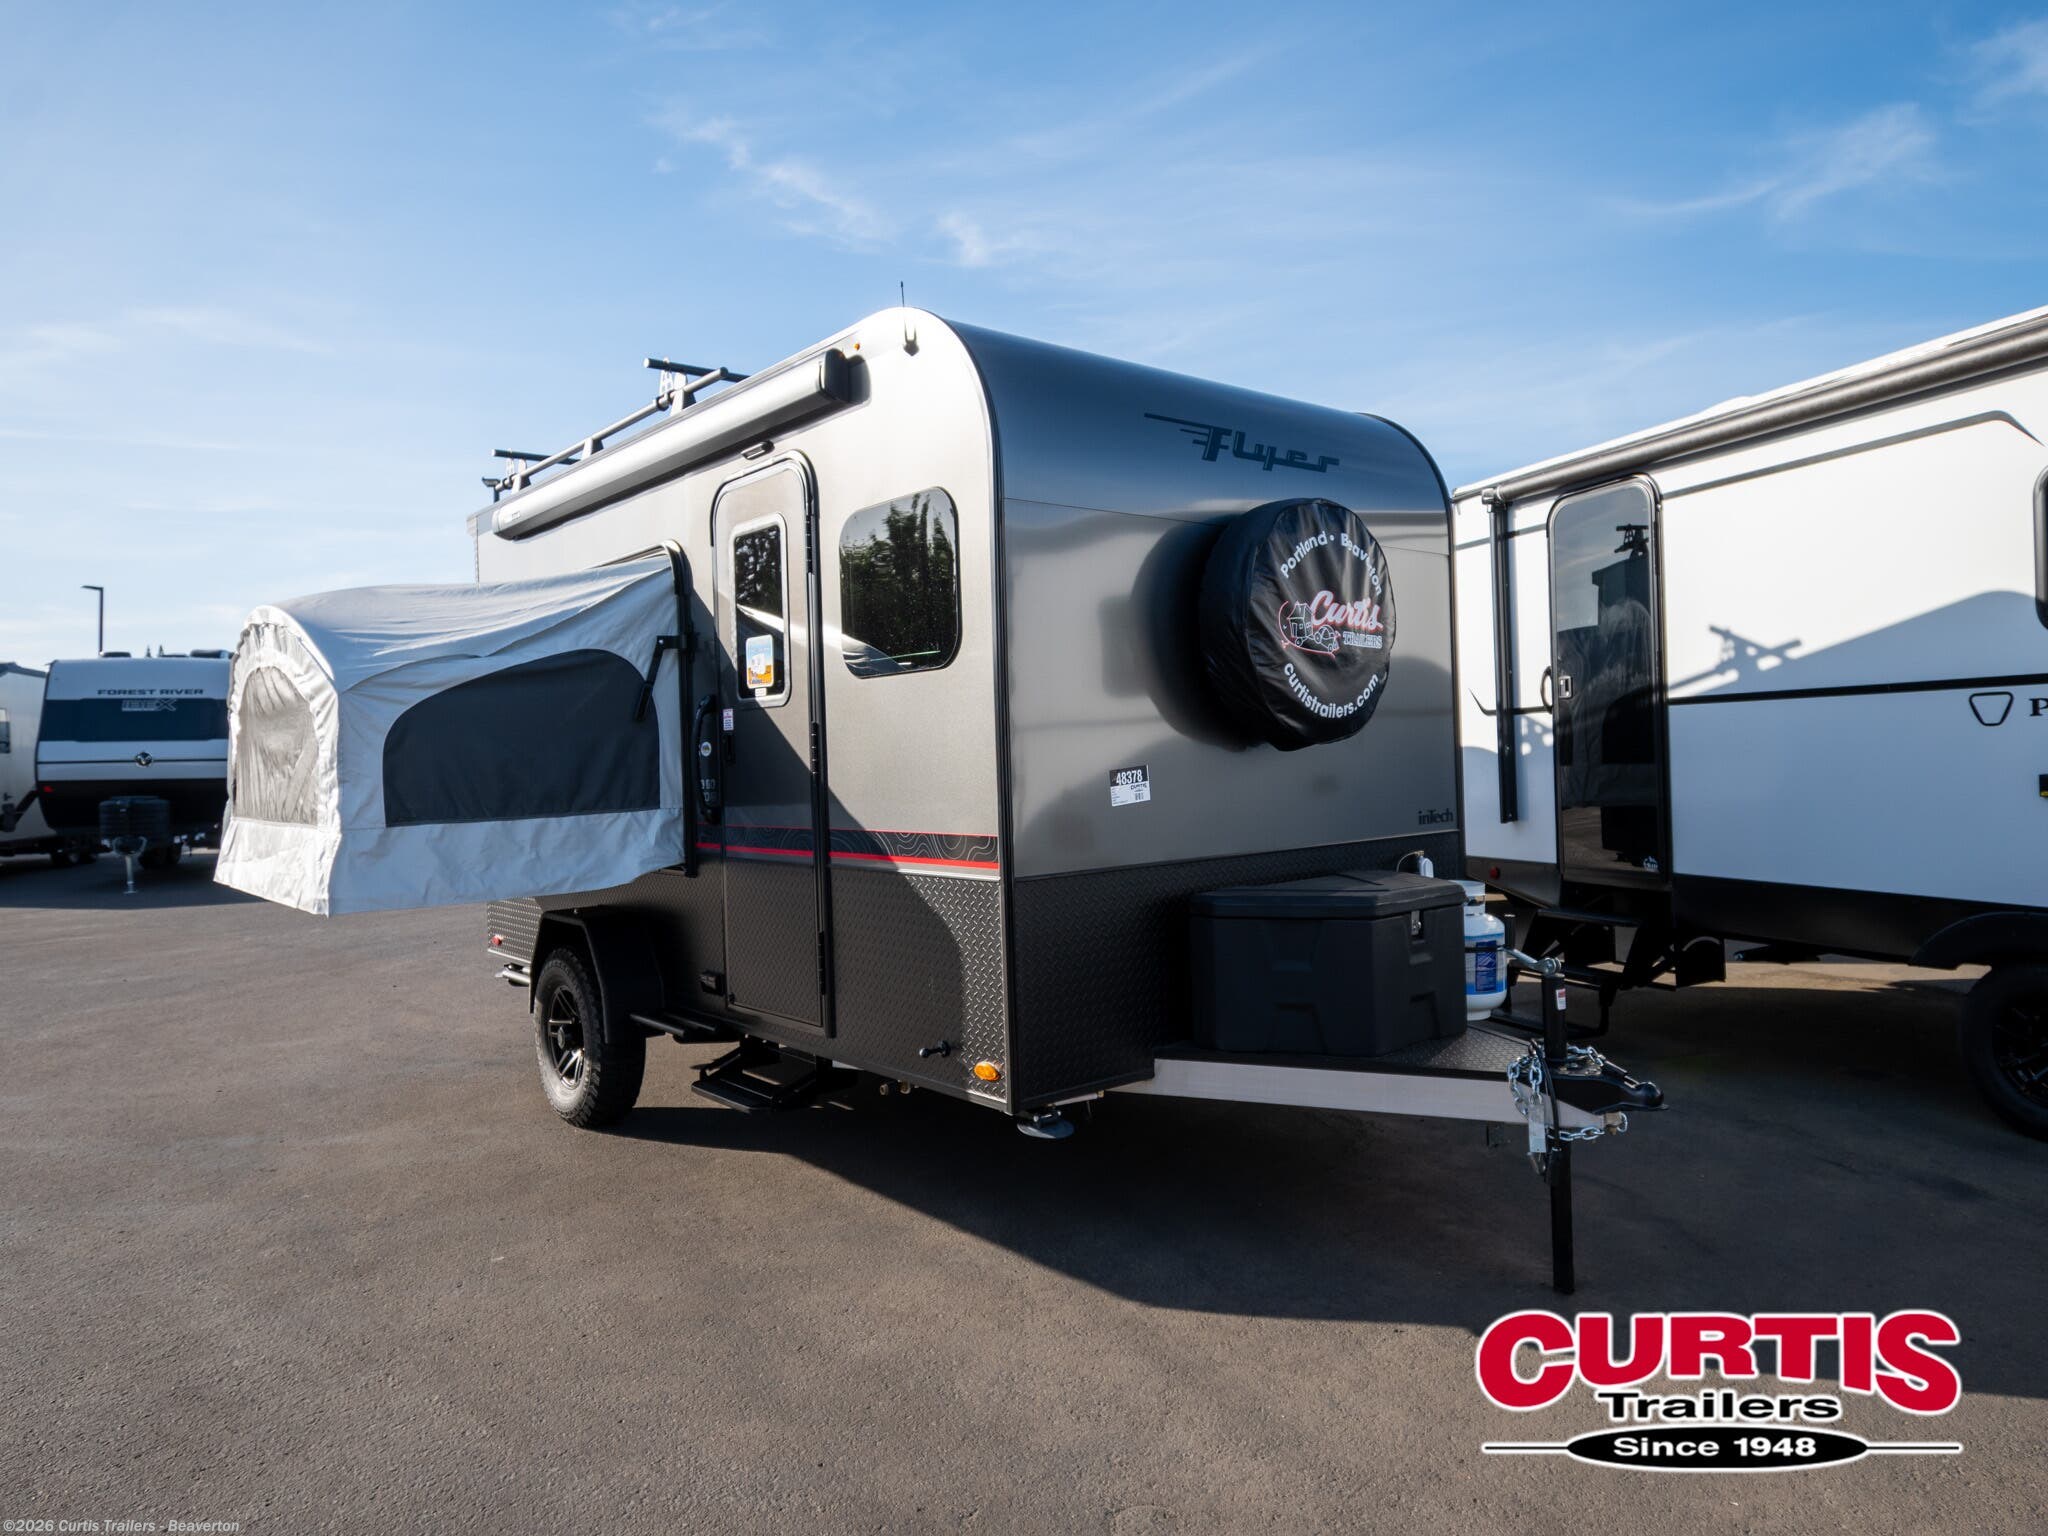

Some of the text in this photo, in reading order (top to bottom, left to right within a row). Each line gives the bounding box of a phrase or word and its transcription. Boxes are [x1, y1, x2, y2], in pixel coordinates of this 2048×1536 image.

[1144, 412, 1339, 473] Flyer
[1280, 530, 1328, 579] Portland
[1310, 590, 1384, 633] Curtis
[97, 688, 157, 696] FOREST
[1283, 662, 1379, 718] Curtistrailers.com
[1115, 769, 1143, 786] 48378
[1418, 807, 1454, 825] inTech
